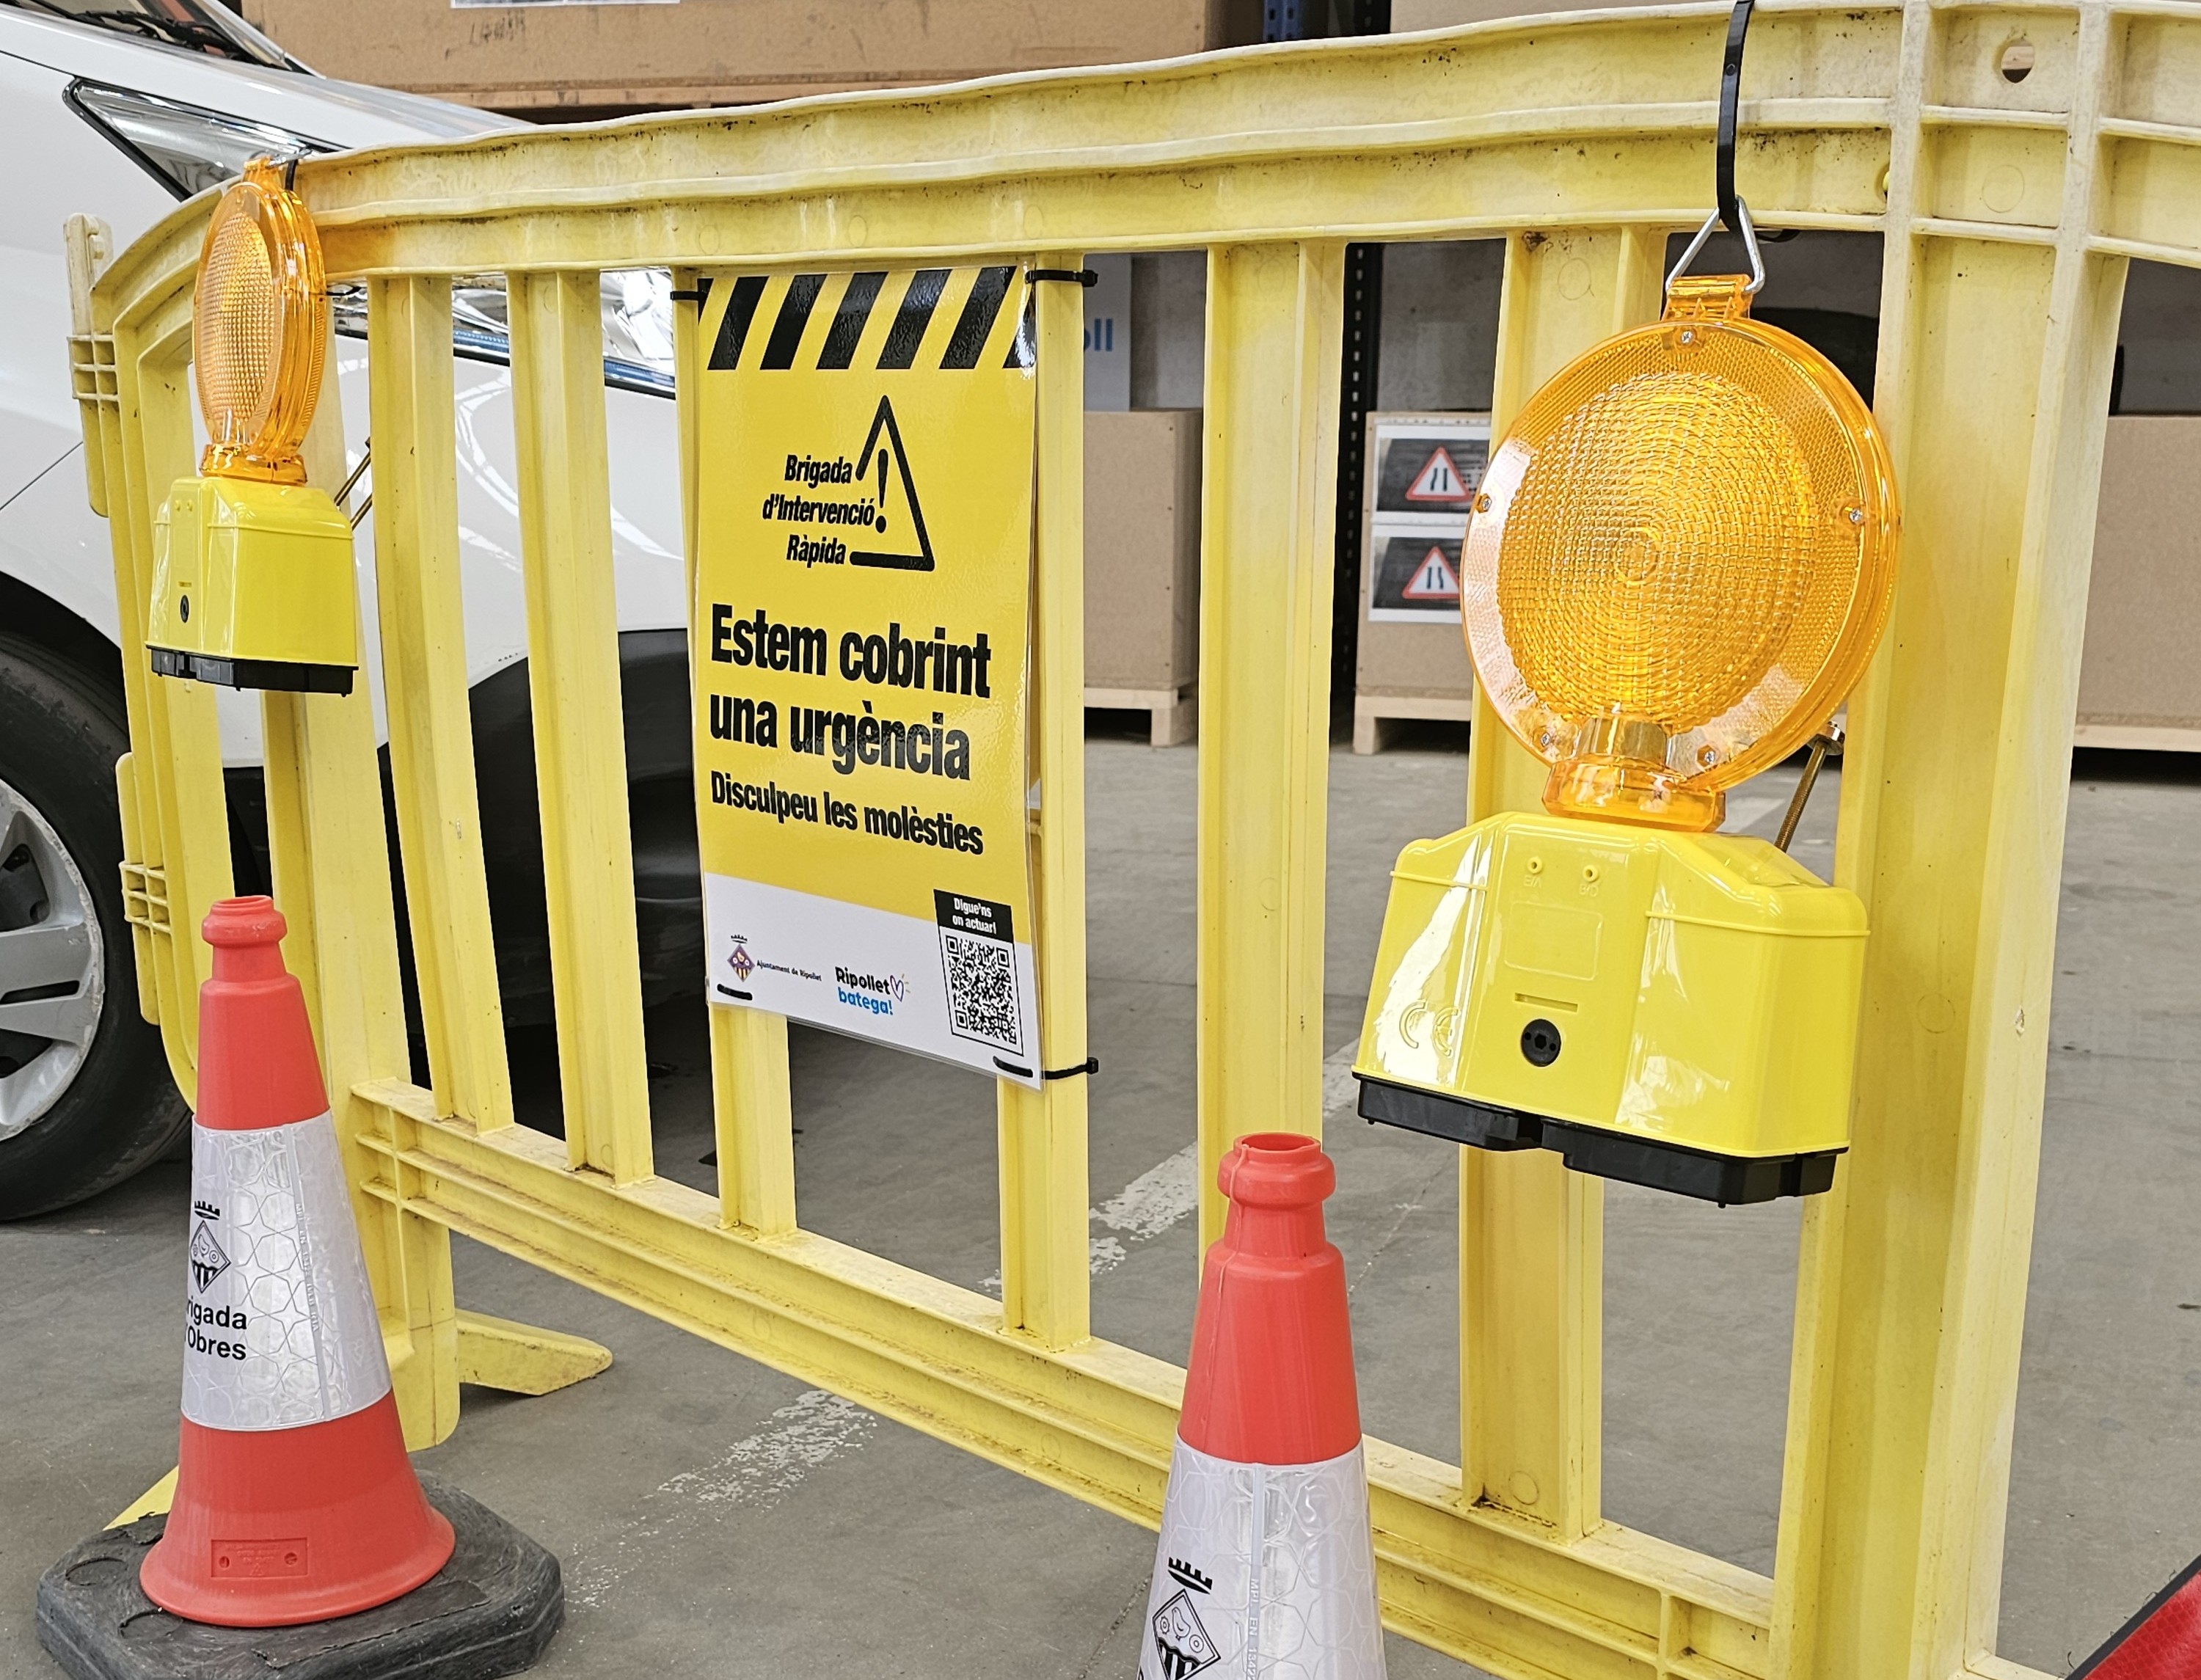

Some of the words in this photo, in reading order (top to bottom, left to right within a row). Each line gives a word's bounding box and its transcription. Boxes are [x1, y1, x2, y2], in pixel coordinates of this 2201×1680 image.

[1083, 317, 1113, 352] ll
[784, 454, 853, 488] Brigada
[762, 494, 875, 526] d'Intervenció
[786, 535, 847, 568] Ràpida
[711, 603, 828, 676] Estem
[839, 622, 992, 698] cobrint
[710, 694, 778, 748] una
[790, 699, 971, 781] urgència
[711, 770, 819, 824] Disculpeu
[823, 791, 858, 830] les
[864, 805, 985, 855] molèsties
[952, 915, 964, 927] on
[953, 897, 992, 918] Digue'ns
[756, 960, 790, 974] Ajuntament
[791, 967, 799, 976] de
[834, 966, 891, 995] Ripollet
[837, 986, 894, 1015] batega!
[187, 1296, 247, 1330] rigada
[1249, 1617, 1258, 1636] EN
